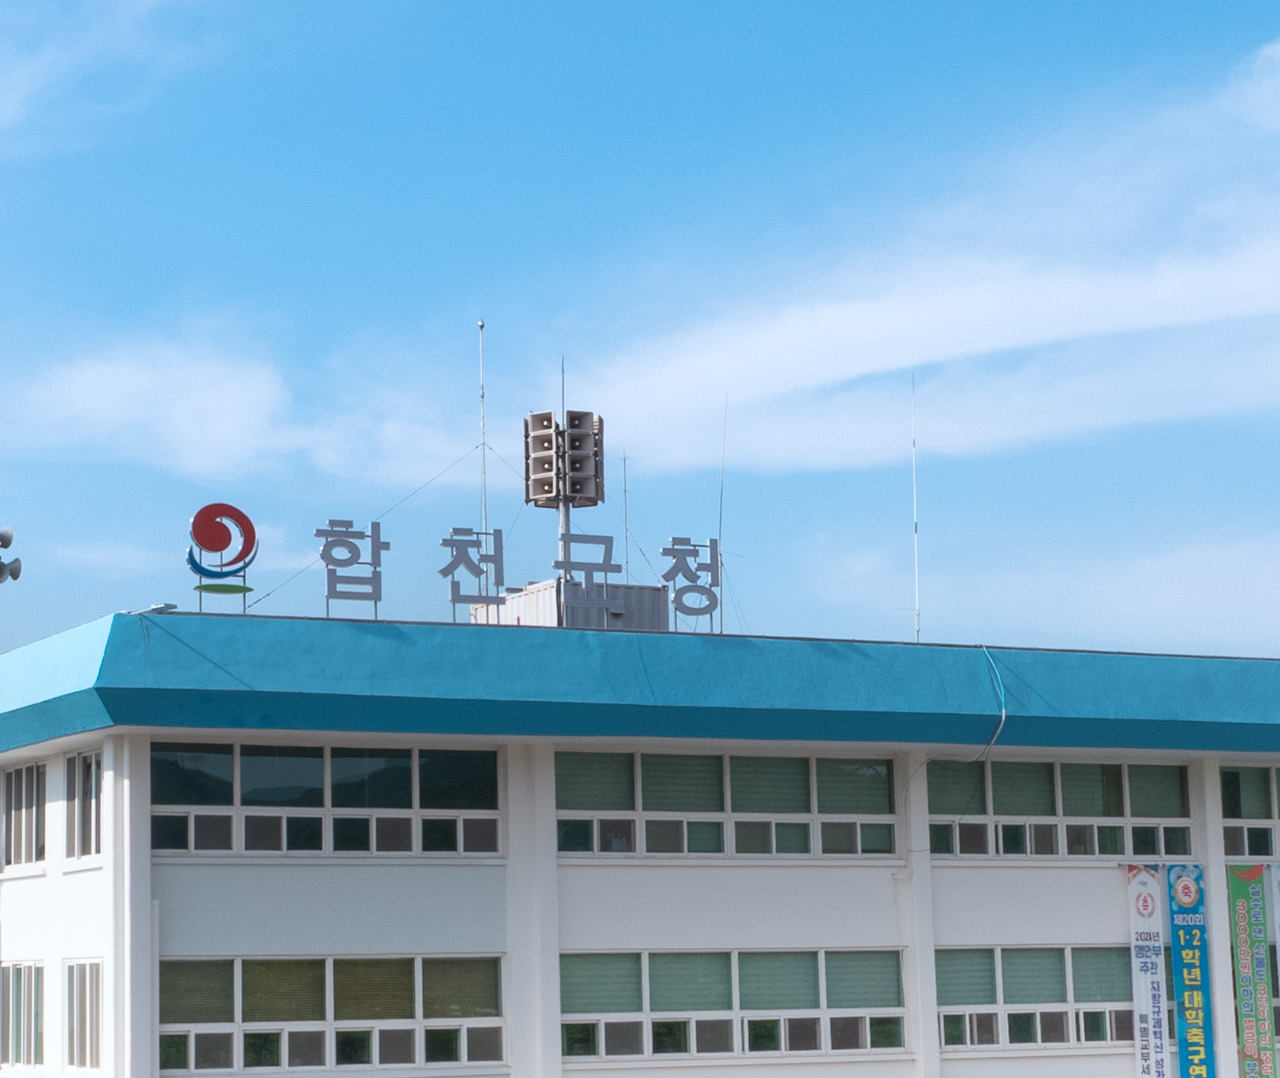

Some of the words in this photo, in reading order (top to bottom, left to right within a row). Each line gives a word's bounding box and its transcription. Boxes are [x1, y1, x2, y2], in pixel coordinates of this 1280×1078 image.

[314, 519, 720, 617] 합천군청
[1181, 884, 1193, 899] 축
[1249, 884, 1263, 923] 실수로
[1173, 914, 1204, 926] 제20회
[1252, 926, 1264, 940] 낸
[1243, 1018, 1258, 1059] 벌금이
[1261, 1052, 1274, 1077] 징역
